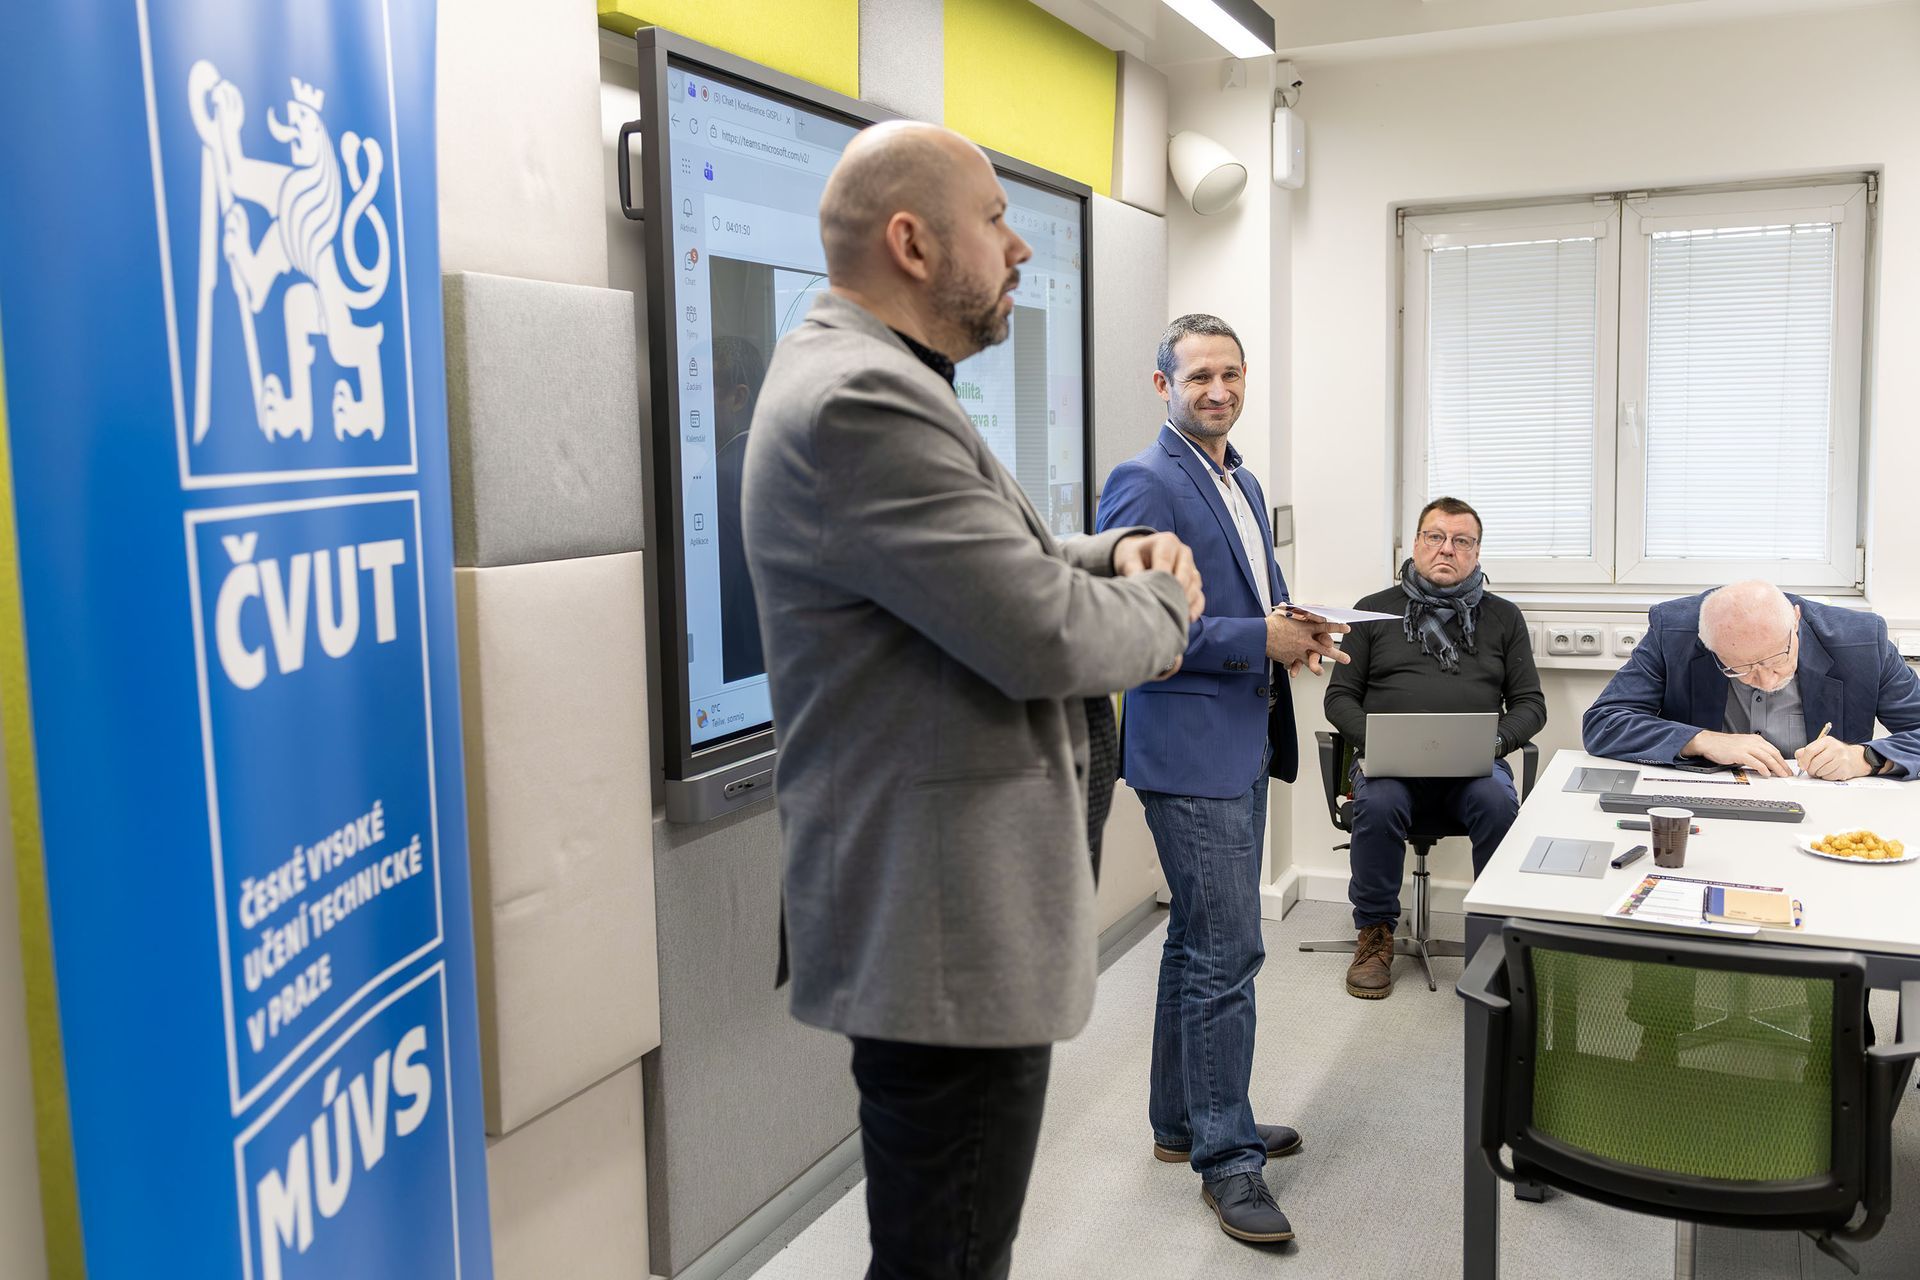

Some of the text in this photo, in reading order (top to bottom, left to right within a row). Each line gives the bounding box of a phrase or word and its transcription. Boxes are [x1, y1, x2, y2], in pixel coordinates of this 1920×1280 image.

[721, 95, 734, 107] Chat
[738, 99, 766, 117] Konference
[721, 130, 810, 164] https://teams.microsoft.com/v2/
[726, 221, 751, 236] 04:01:50
[955, 382, 984, 404] bilita,
[968, 414, 998, 427] rava a
[215, 531, 405, 690] ČVUT
[727, 712, 745, 724] sonnig
[239, 799, 385, 929] ČESKÉ VYSOKÉ
[243, 834, 423, 992] UČENÍ TECHNICKÉ
[246, 952, 333, 1054] V PRAZE
[256, 1025, 432, 1280] MÚVS
